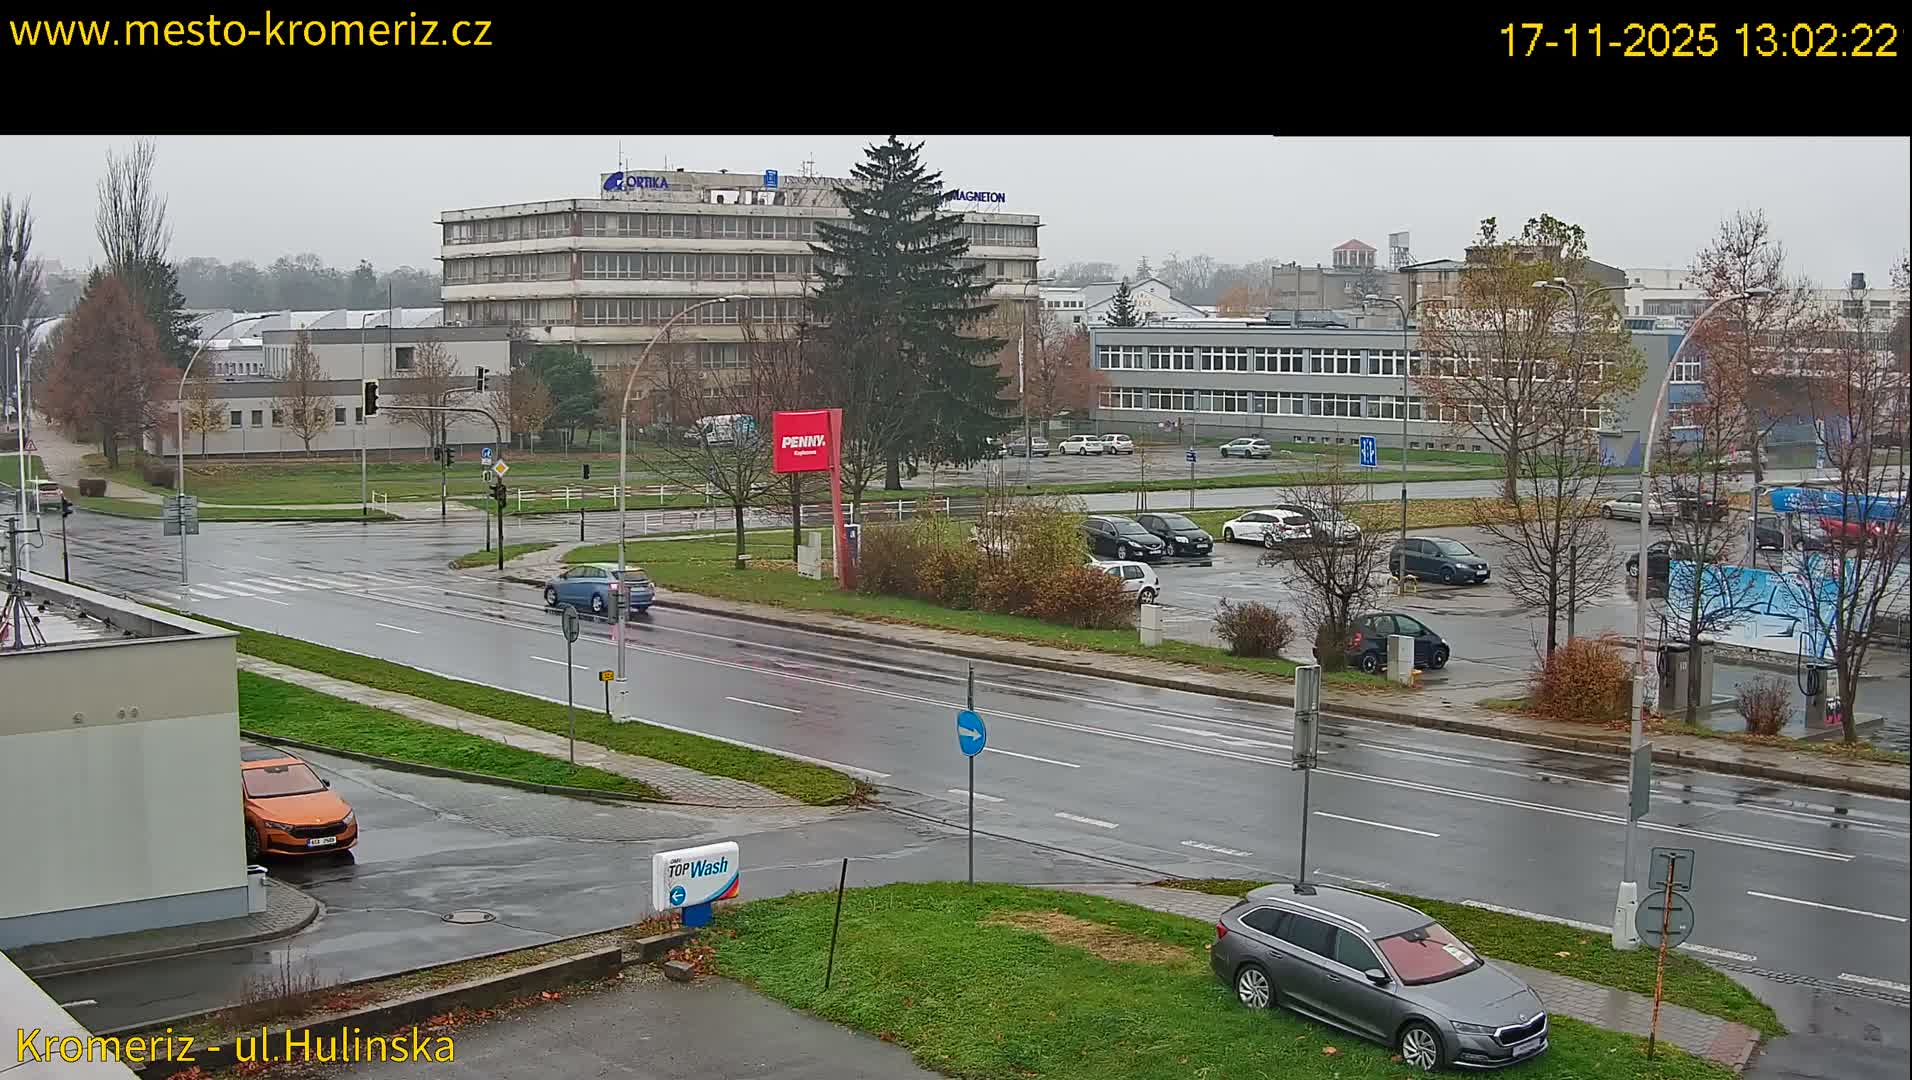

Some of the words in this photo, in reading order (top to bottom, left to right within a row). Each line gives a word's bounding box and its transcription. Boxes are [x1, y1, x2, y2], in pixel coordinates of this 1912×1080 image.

[626, 175, 669, 189] ORTIKA
[669, 863, 690, 877] TOP
[691, 856, 728, 878] Wash
